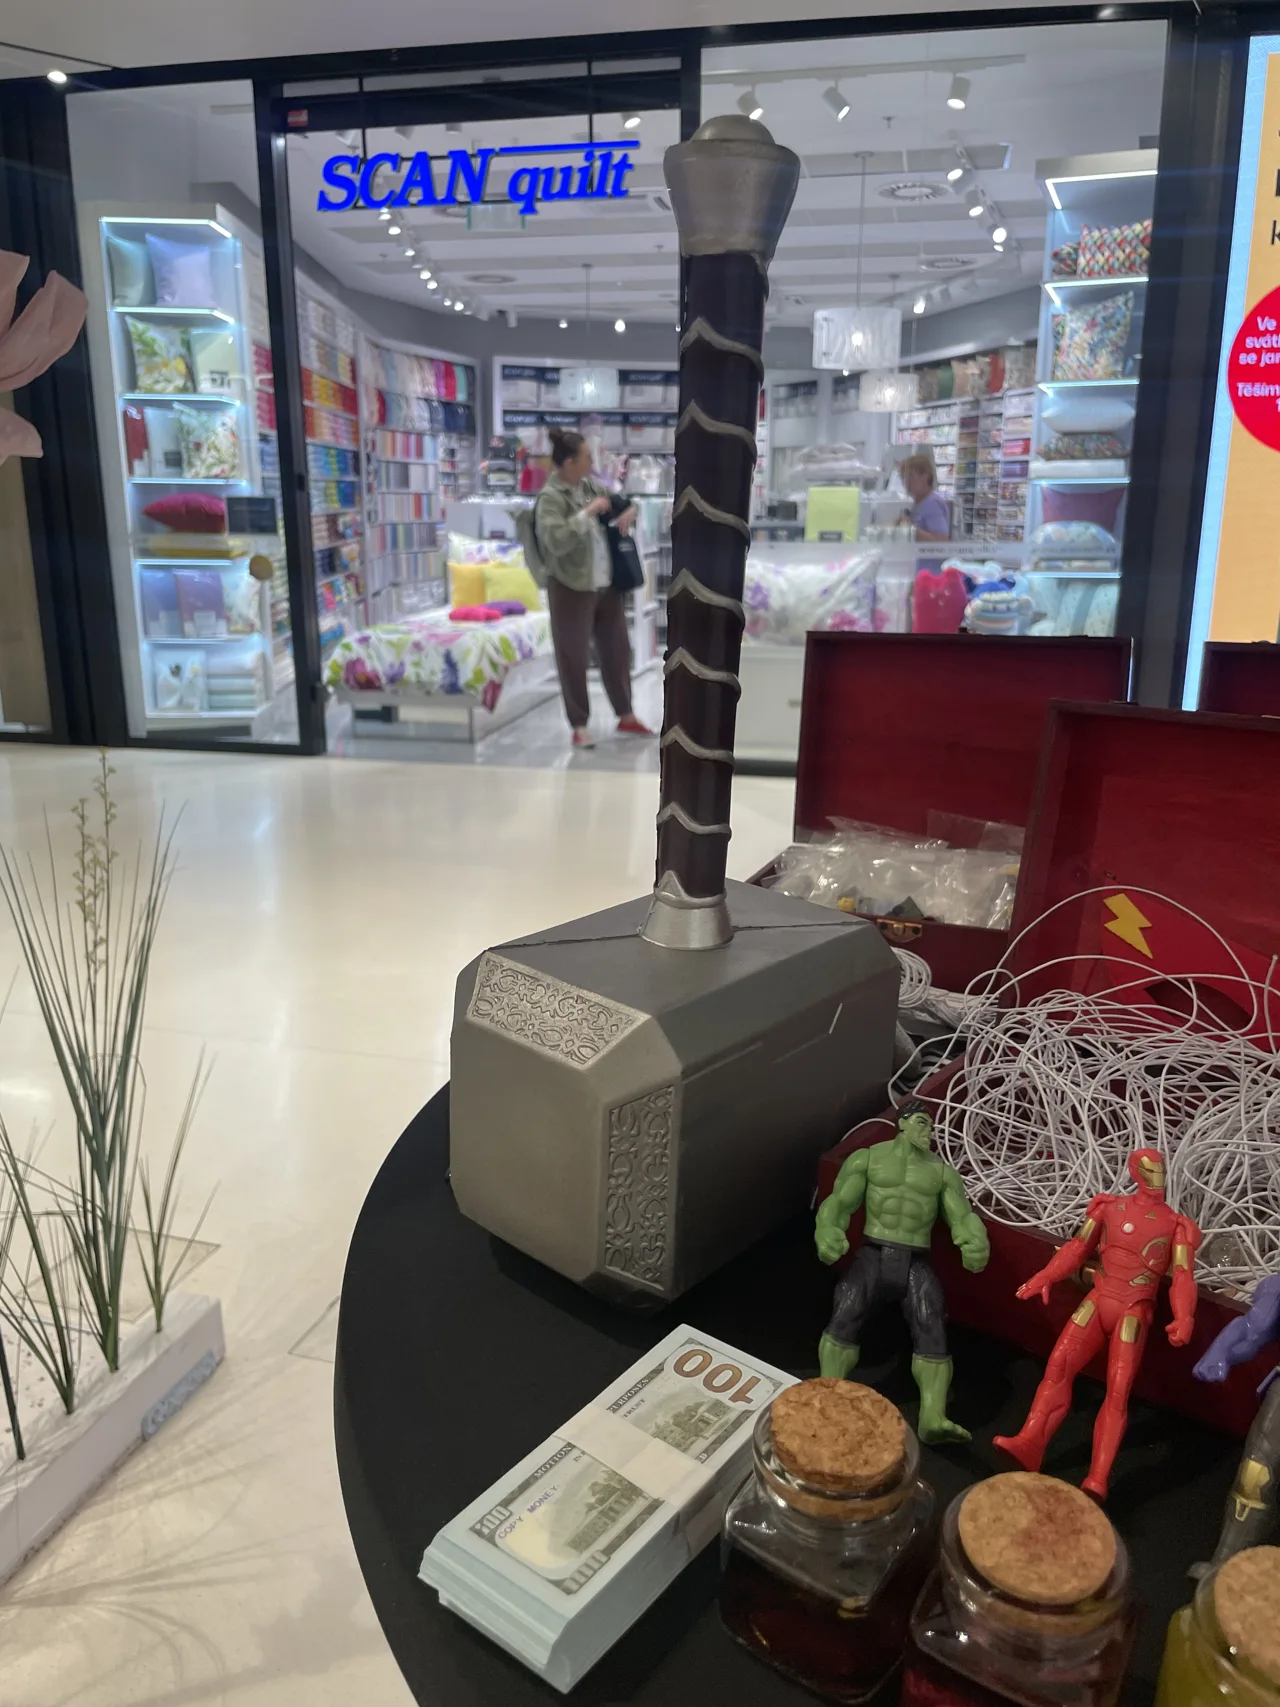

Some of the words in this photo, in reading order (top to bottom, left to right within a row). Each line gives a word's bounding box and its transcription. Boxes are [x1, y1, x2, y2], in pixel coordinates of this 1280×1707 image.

[317, 148, 496, 212] SCAN
[508, 149, 635, 215] quilt
[1257, 316, 1277, 331] Ve
[1238, 352, 1258, 365] se
[673, 1349, 762, 1404] 100
[623, 1397, 646, 1418] TRUST
[533, 1444, 573, 1479] MOTION
[498, 1515, 524, 1539] COPY
[526, 1484, 558, 1514] MONEY
